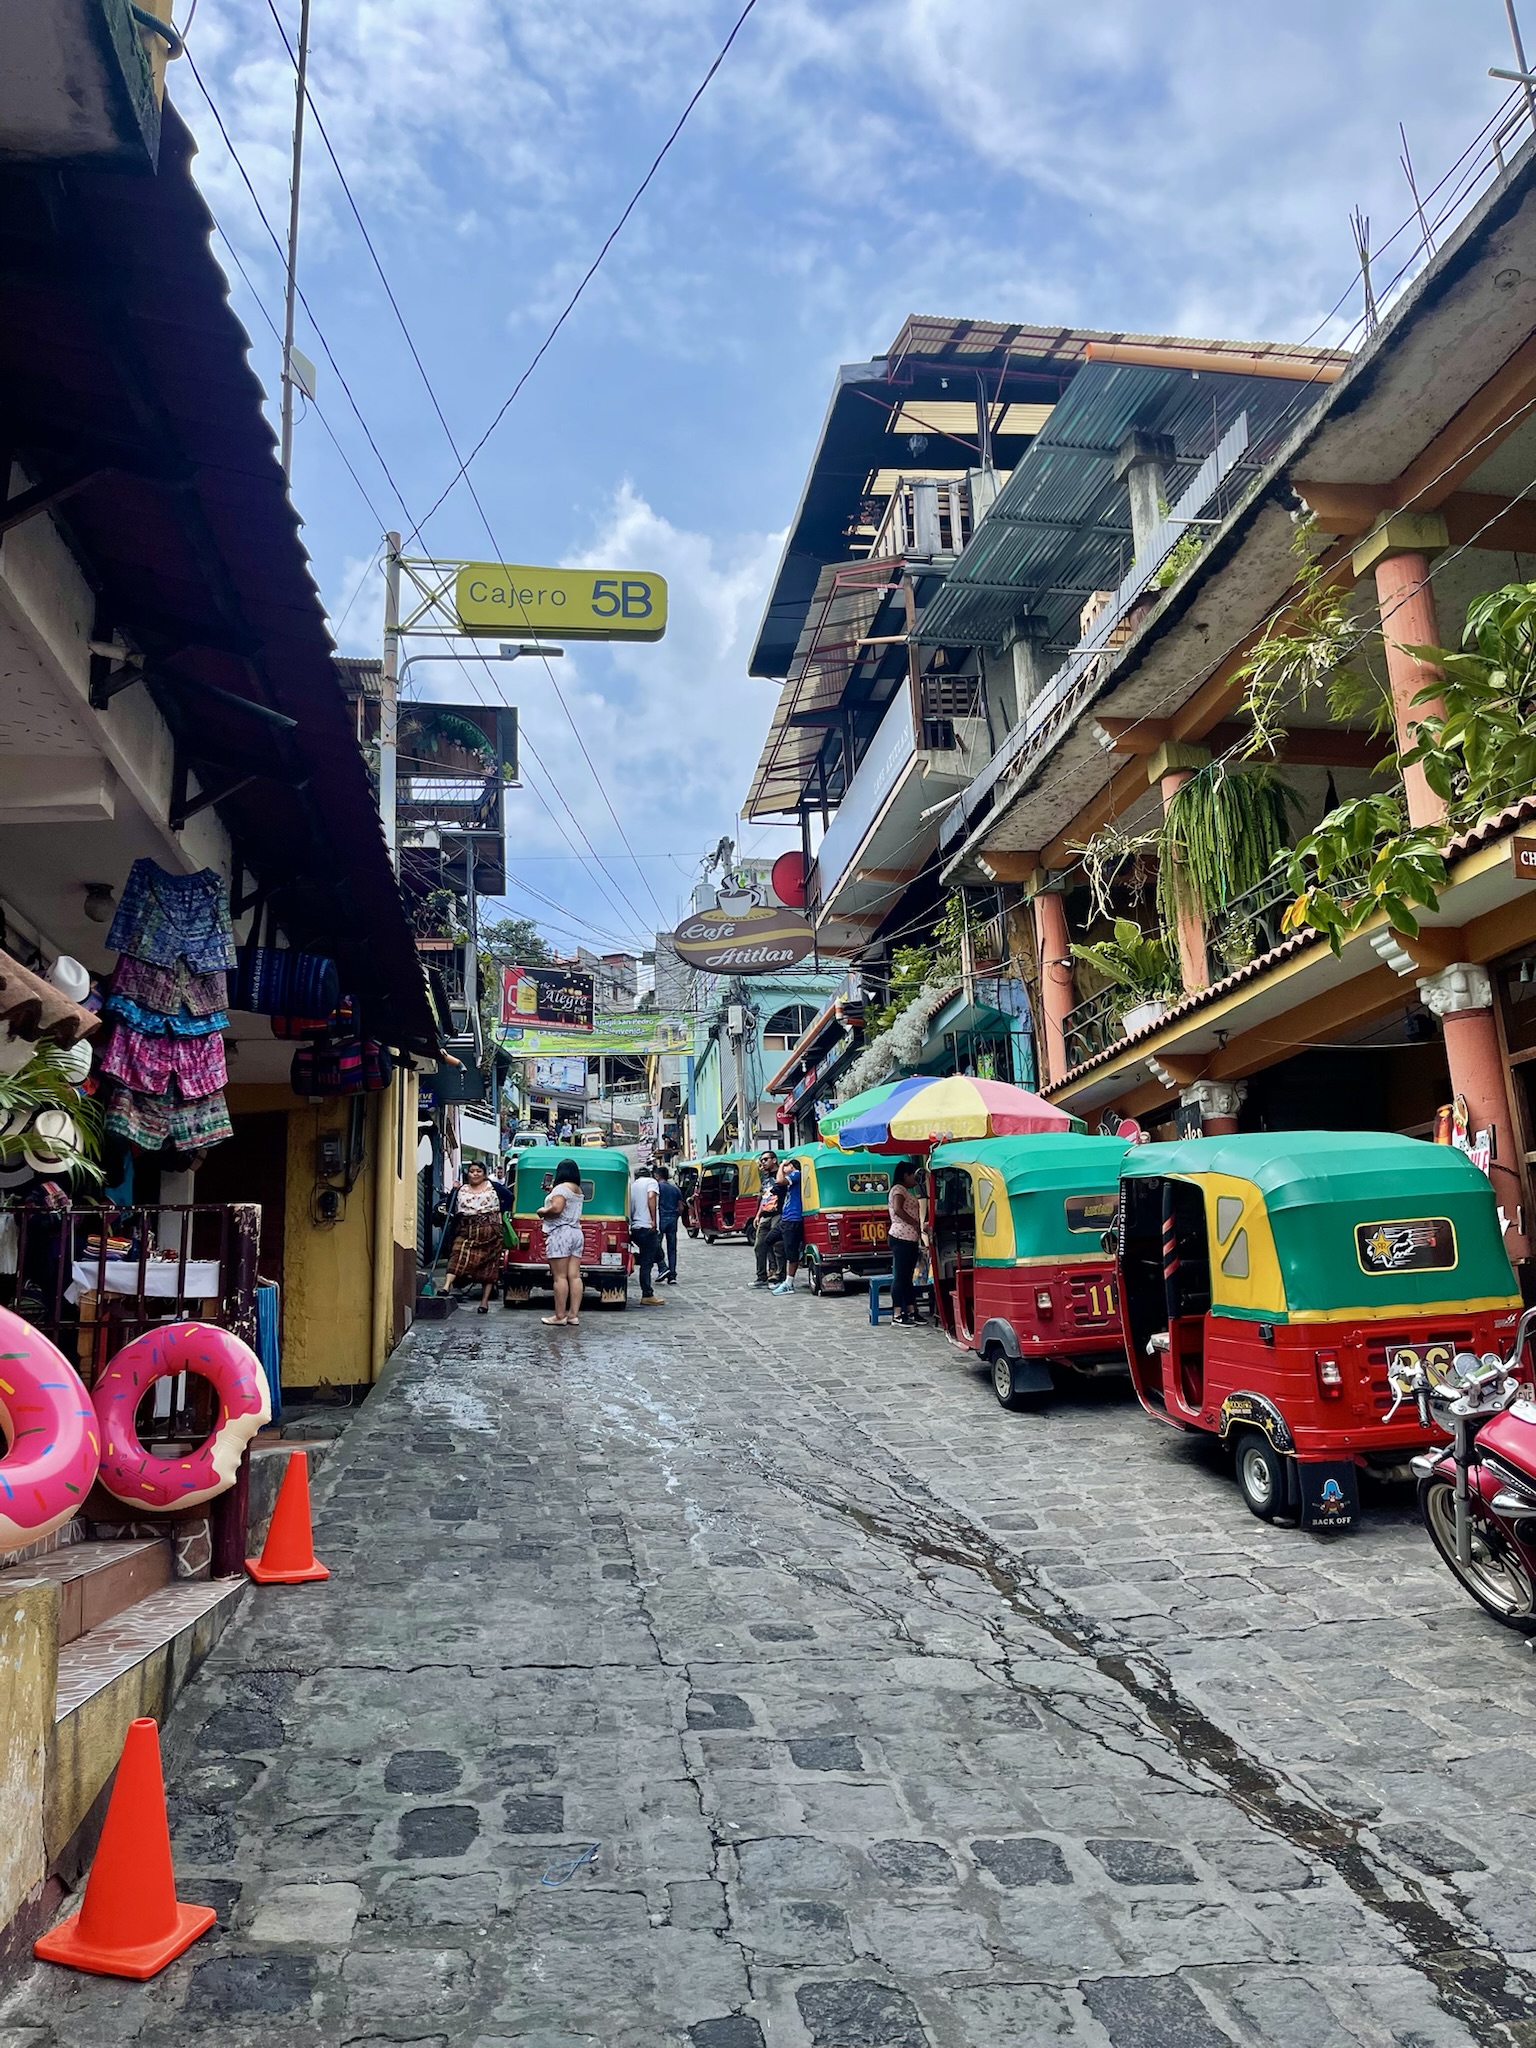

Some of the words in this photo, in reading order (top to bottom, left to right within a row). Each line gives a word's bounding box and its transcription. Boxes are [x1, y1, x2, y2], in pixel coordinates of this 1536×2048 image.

[469, 581, 567, 608] Cajero
[591, 579, 653, 619] 5B
[681, 922, 736, 941] Café
[705, 947, 794, 967] Atitlan
[539, 988, 588, 1009] Alegre
[861, 1223, 885, 1240] 106
[1312, 1517, 1335, 1526] BACK
[1336, 1516, 1352, 1524] OFF
